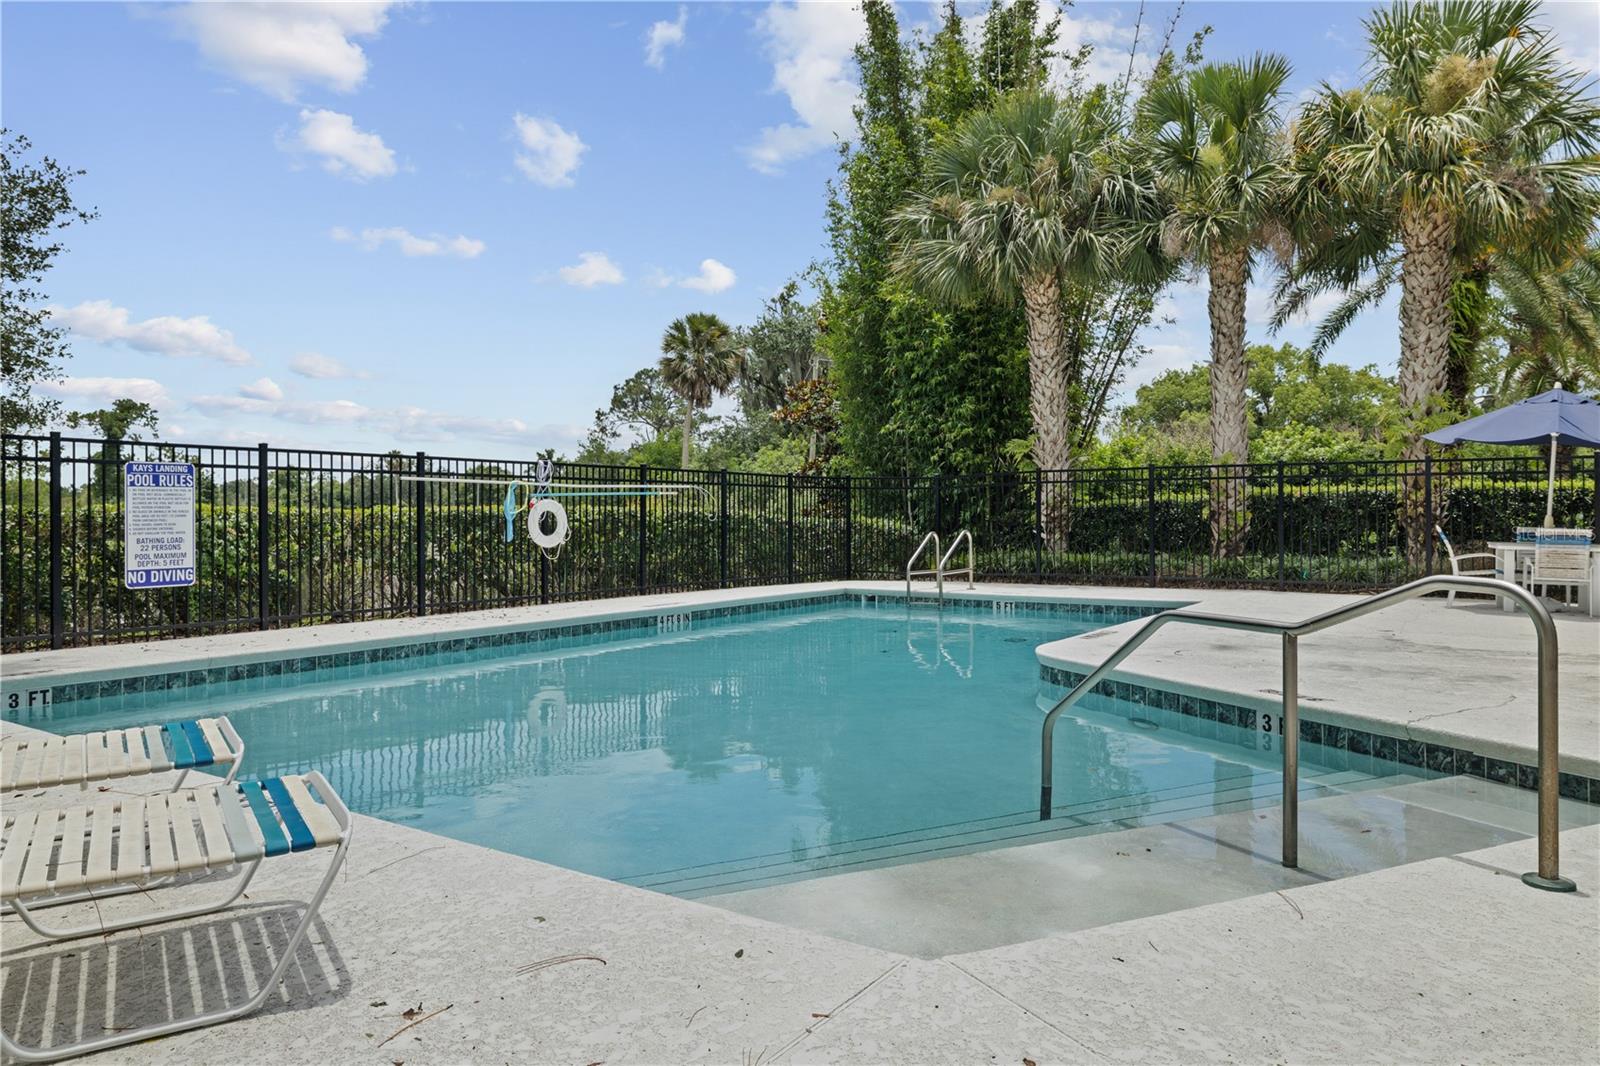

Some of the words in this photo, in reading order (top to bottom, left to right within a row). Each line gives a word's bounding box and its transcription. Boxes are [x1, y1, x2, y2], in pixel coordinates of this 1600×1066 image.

[132, 464, 153, 472] KAYS
[155, 464, 188, 473] LANDING
[127, 474, 156, 487] POOL
[159, 474, 193, 487] RULES
[136, 537, 165, 545] BATHING
[166, 536, 185, 544] LOAD:
[140, 544, 149, 552] 22
[153, 552, 187, 560] MAXIMUM
[127, 571, 146, 584] NO
[150, 568, 194, 583] DIVING
[996, 601, 1001, 609] 5
[1004, 601, 1014, 609] FT
[8, 693, 19, 709] 3
[28, 689, 50, 707] FT.
[1262, 713, 1272, 732] 3
